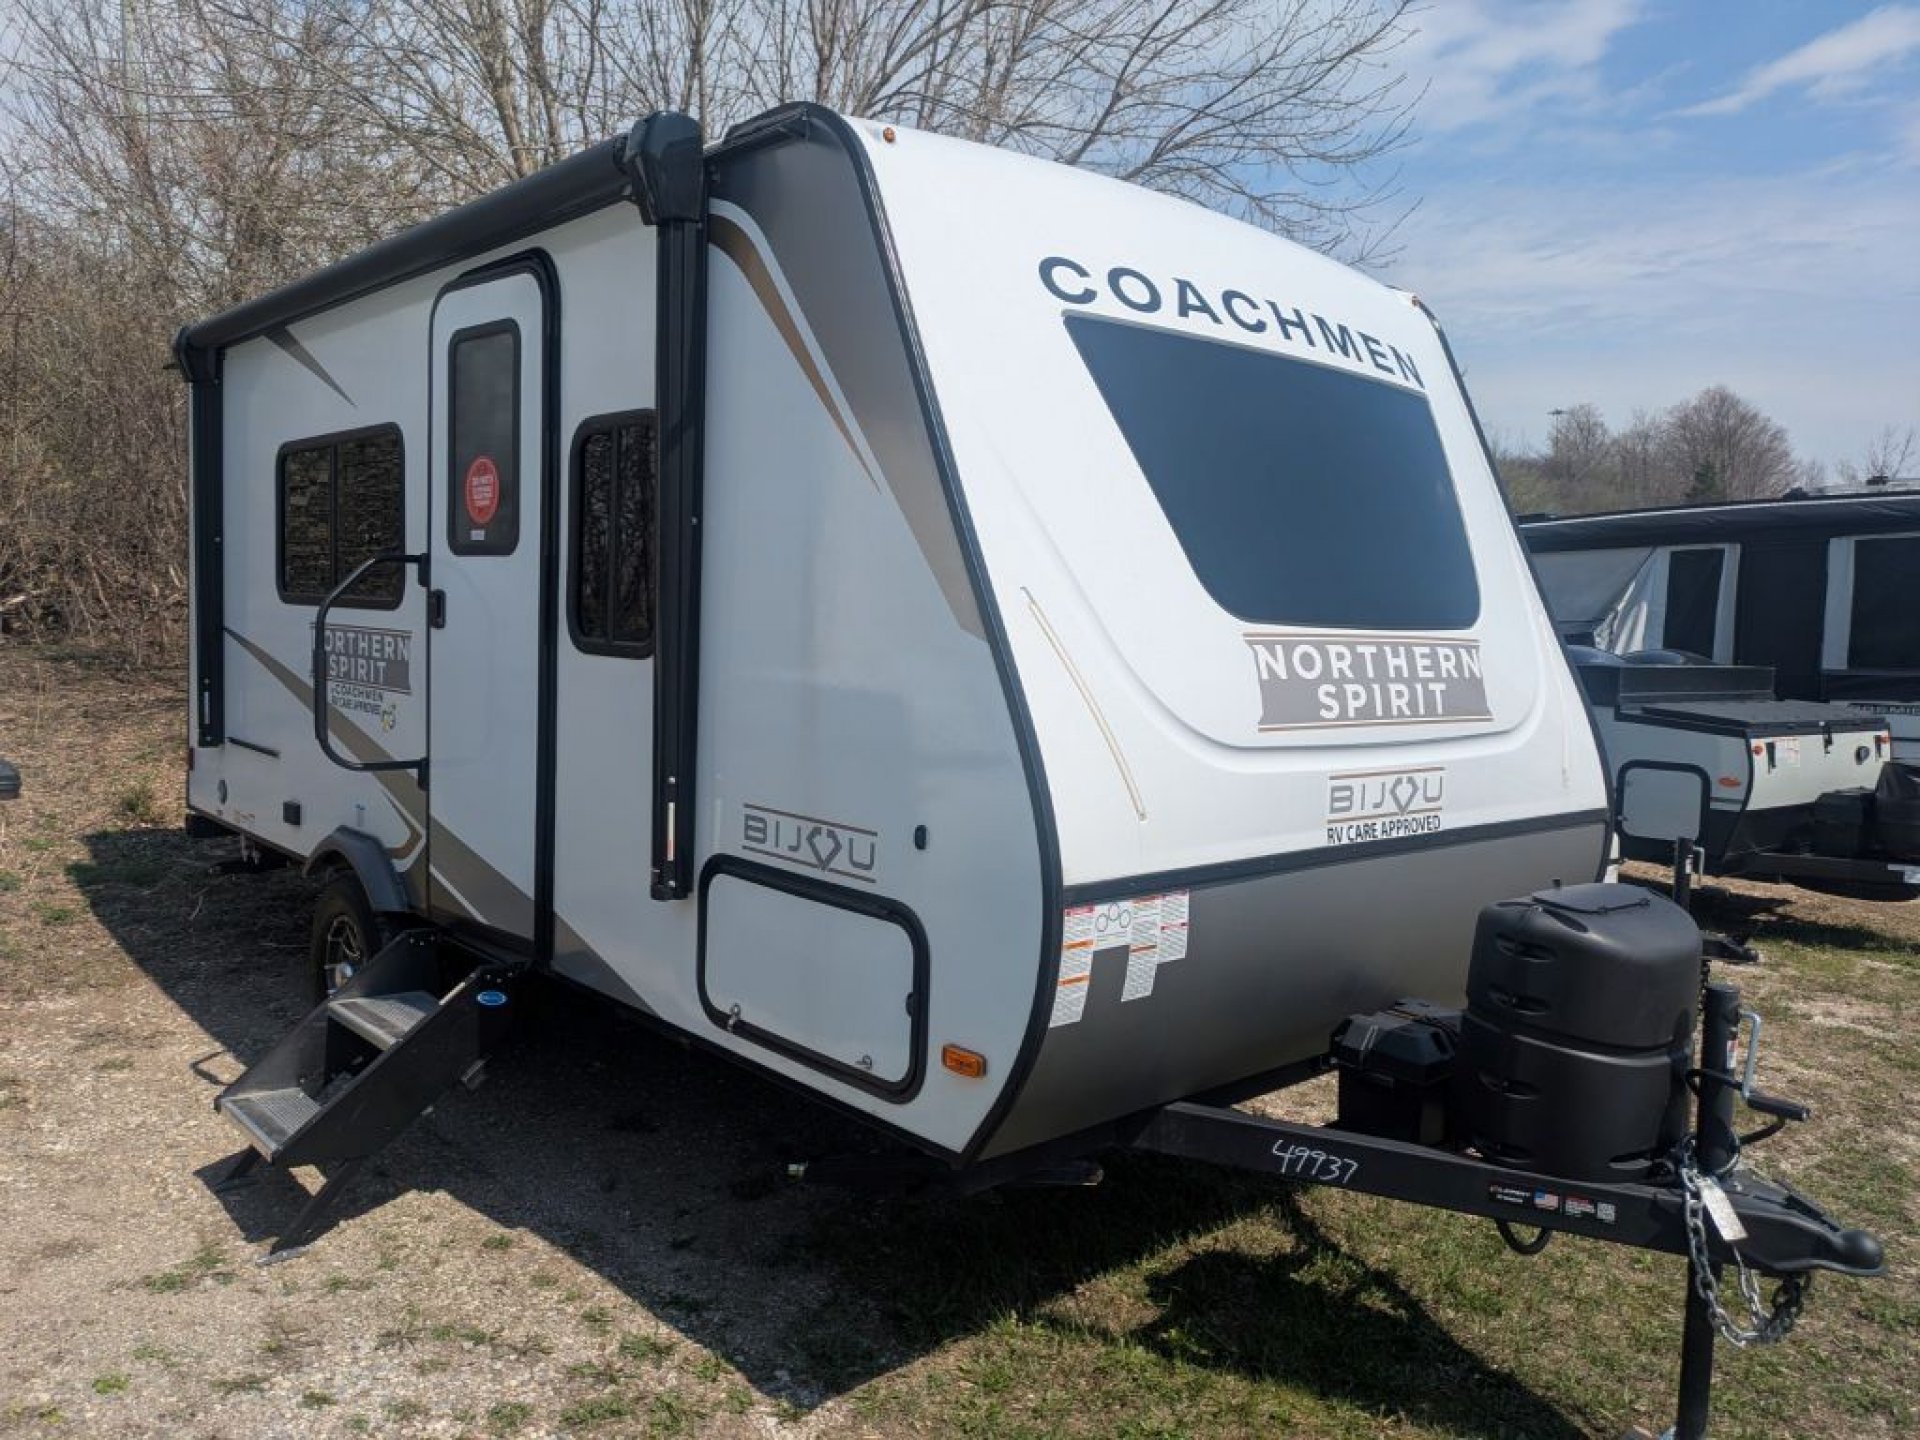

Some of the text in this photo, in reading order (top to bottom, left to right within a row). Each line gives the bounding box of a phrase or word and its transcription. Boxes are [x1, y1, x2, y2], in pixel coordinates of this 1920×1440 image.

[1038, 256, 1425, 390] COACHMEN
[322, 629, 409, 661] ORTHERN
[1253, 644, 1482, 680] NORTHERN
[329, 654, 387, 684] SPIRIT
[1317, 682, 1447, 719] SPIRIT
[1326, 815, 1441, 844] RV CARE APPROVED
[1272, 1139, 1358, 1184] 49937
